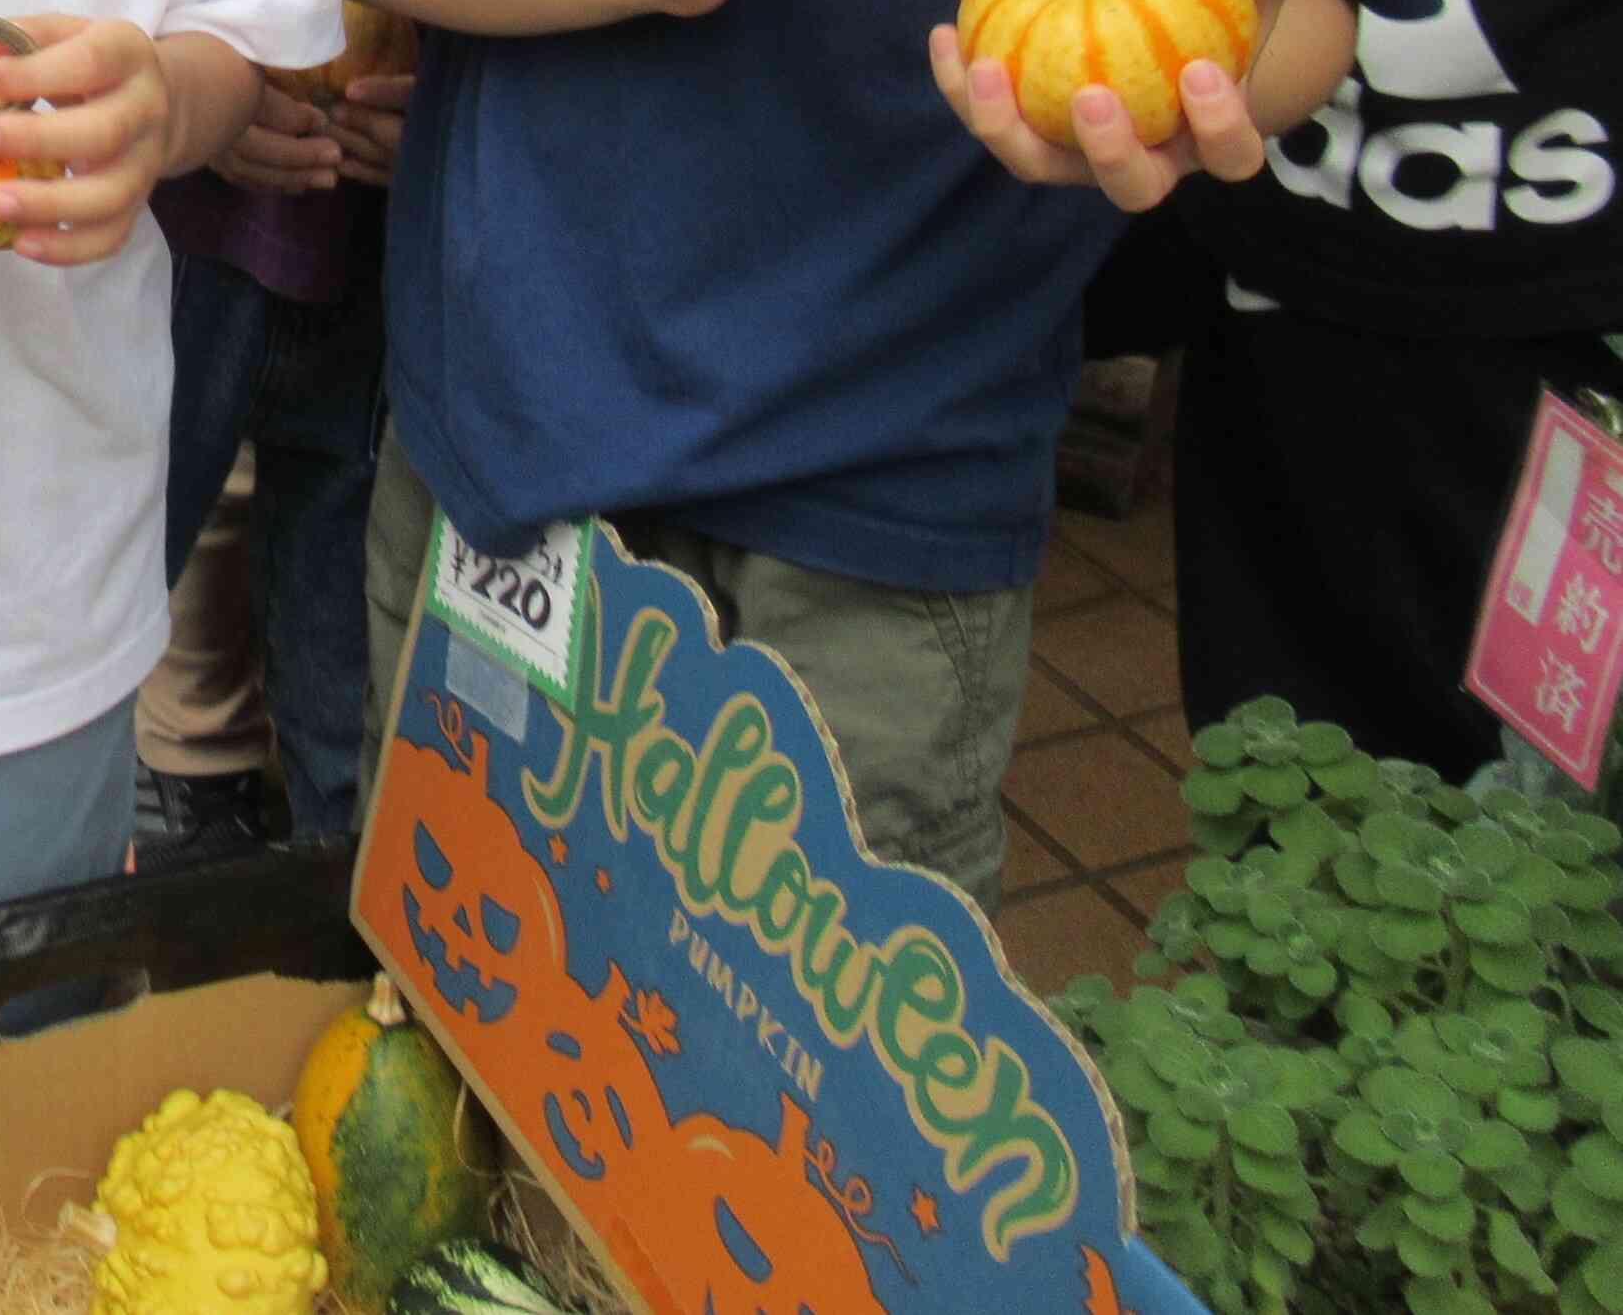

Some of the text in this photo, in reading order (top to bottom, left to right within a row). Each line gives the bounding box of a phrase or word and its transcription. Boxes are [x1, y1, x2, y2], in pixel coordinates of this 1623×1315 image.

[1536, 491, 1623, 734] 売約済
[521, 571, 1080, 1264] Halloween
[669, 908, 825, 1102] PUMPKIN
